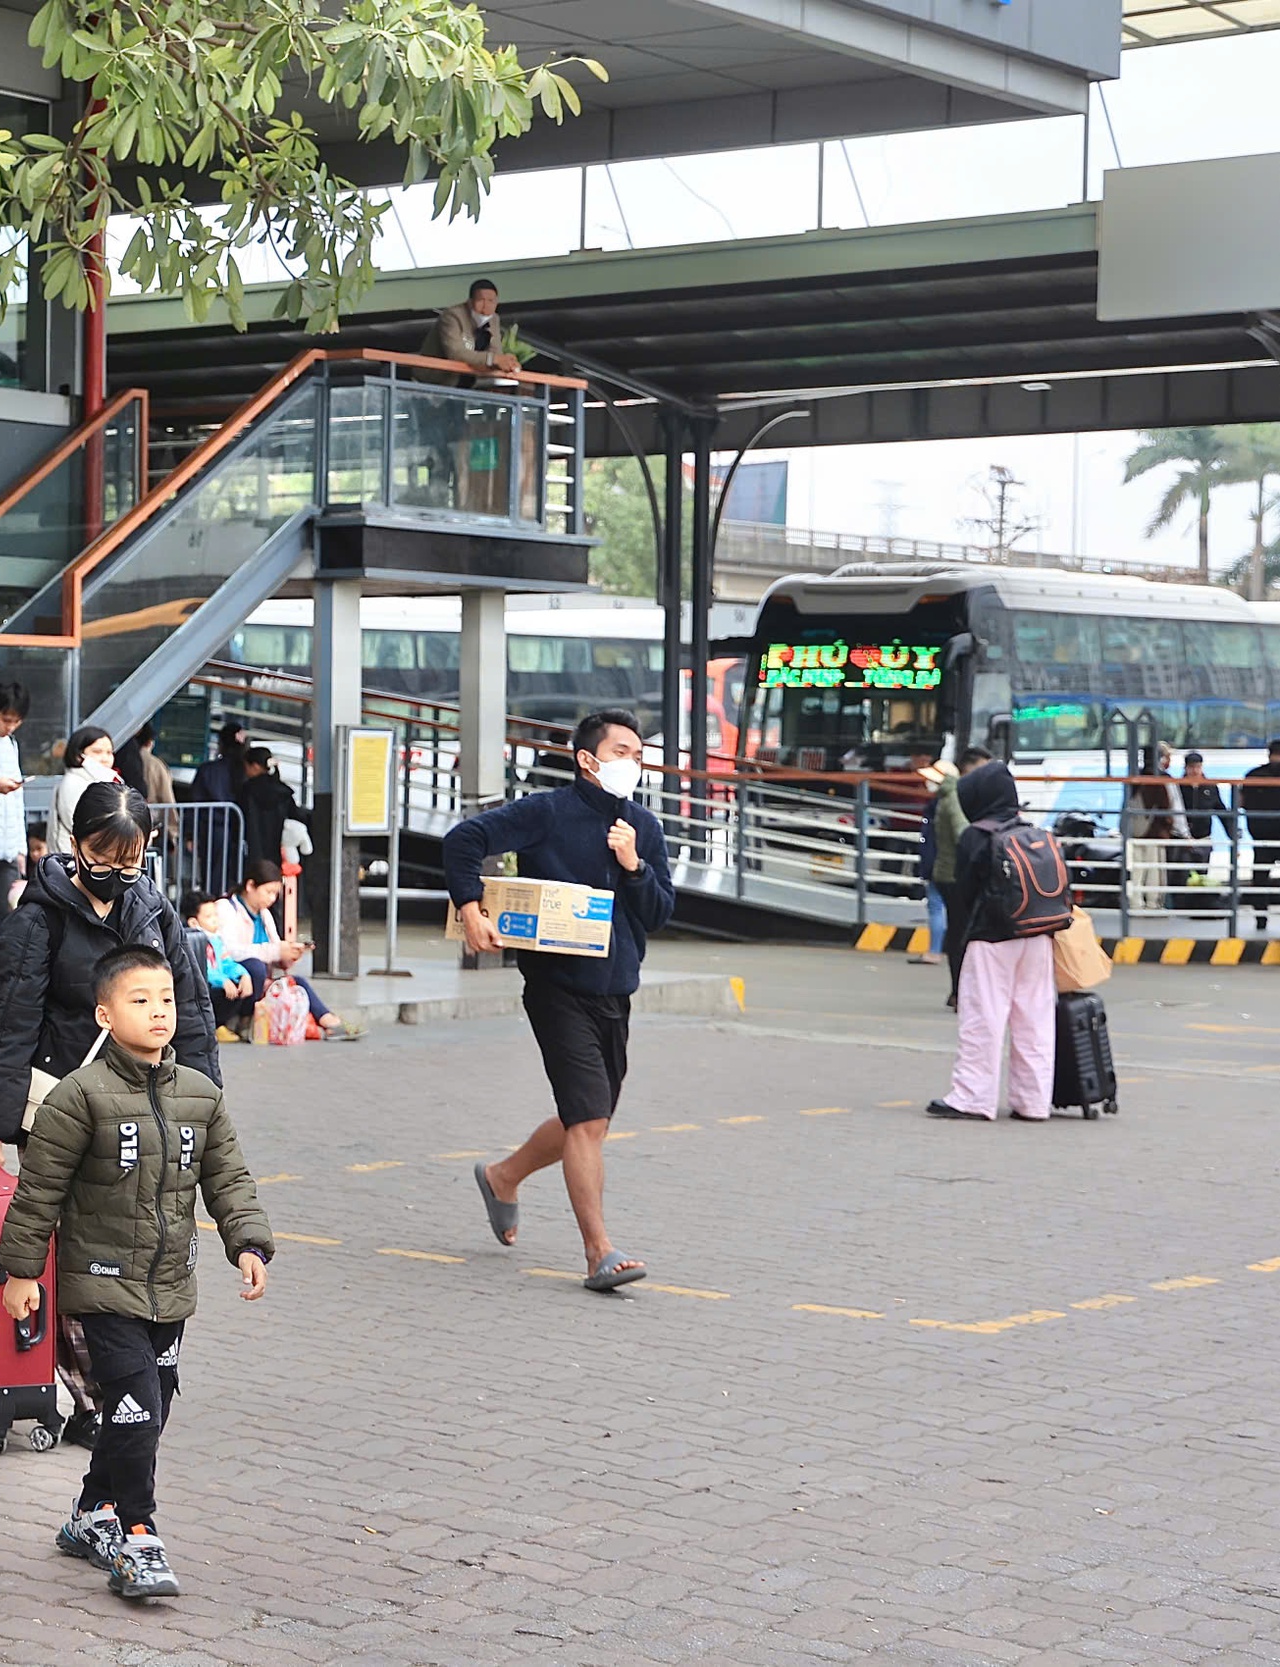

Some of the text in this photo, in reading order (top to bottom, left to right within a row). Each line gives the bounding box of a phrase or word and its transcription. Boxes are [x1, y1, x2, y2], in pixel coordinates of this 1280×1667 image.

[767, 638, 849, 669] PHÚ
[542, 897, 562, 910] true
[501, 914, 511, 932] 3
[111, 1410, 151, 1424] adidas
